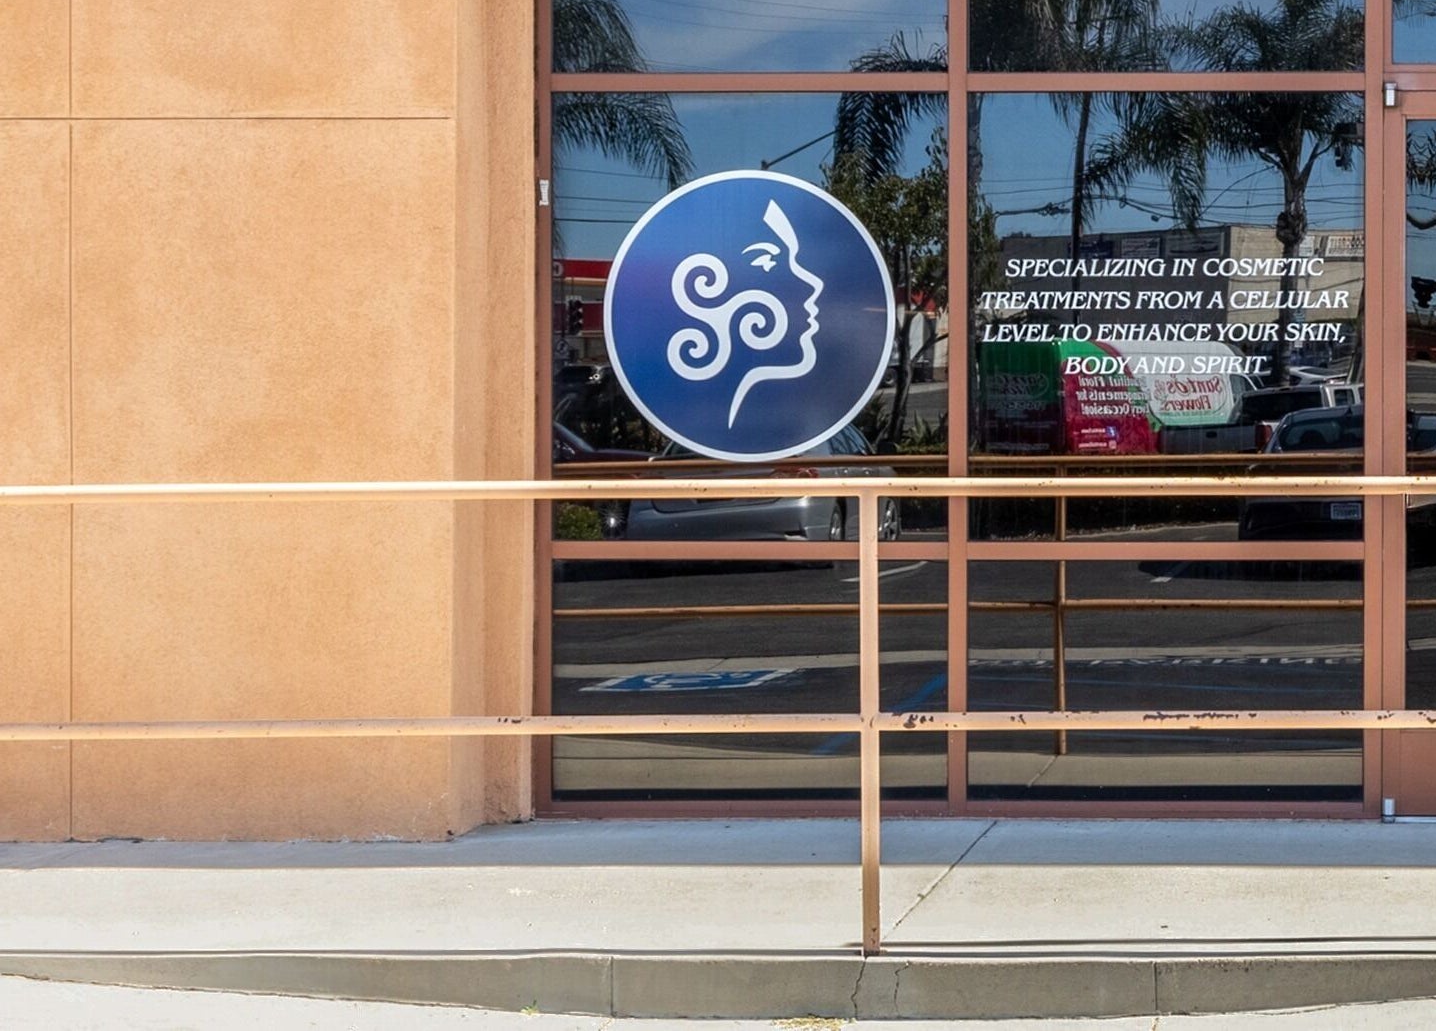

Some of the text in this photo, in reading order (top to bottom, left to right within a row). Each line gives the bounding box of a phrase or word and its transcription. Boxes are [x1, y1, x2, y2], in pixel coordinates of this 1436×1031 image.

[1005, 257, 1325, 278] SPECIALIZING IN COSMETIC
[981, 289, 1350, 310] TREATMENTS FROM A CELLULAR
[983, 322, 1347, 345] LEVEL TO ENHANCE YOUR SKIN,
[1065, 355, 1267, 375] BODY AND SPIRIT
